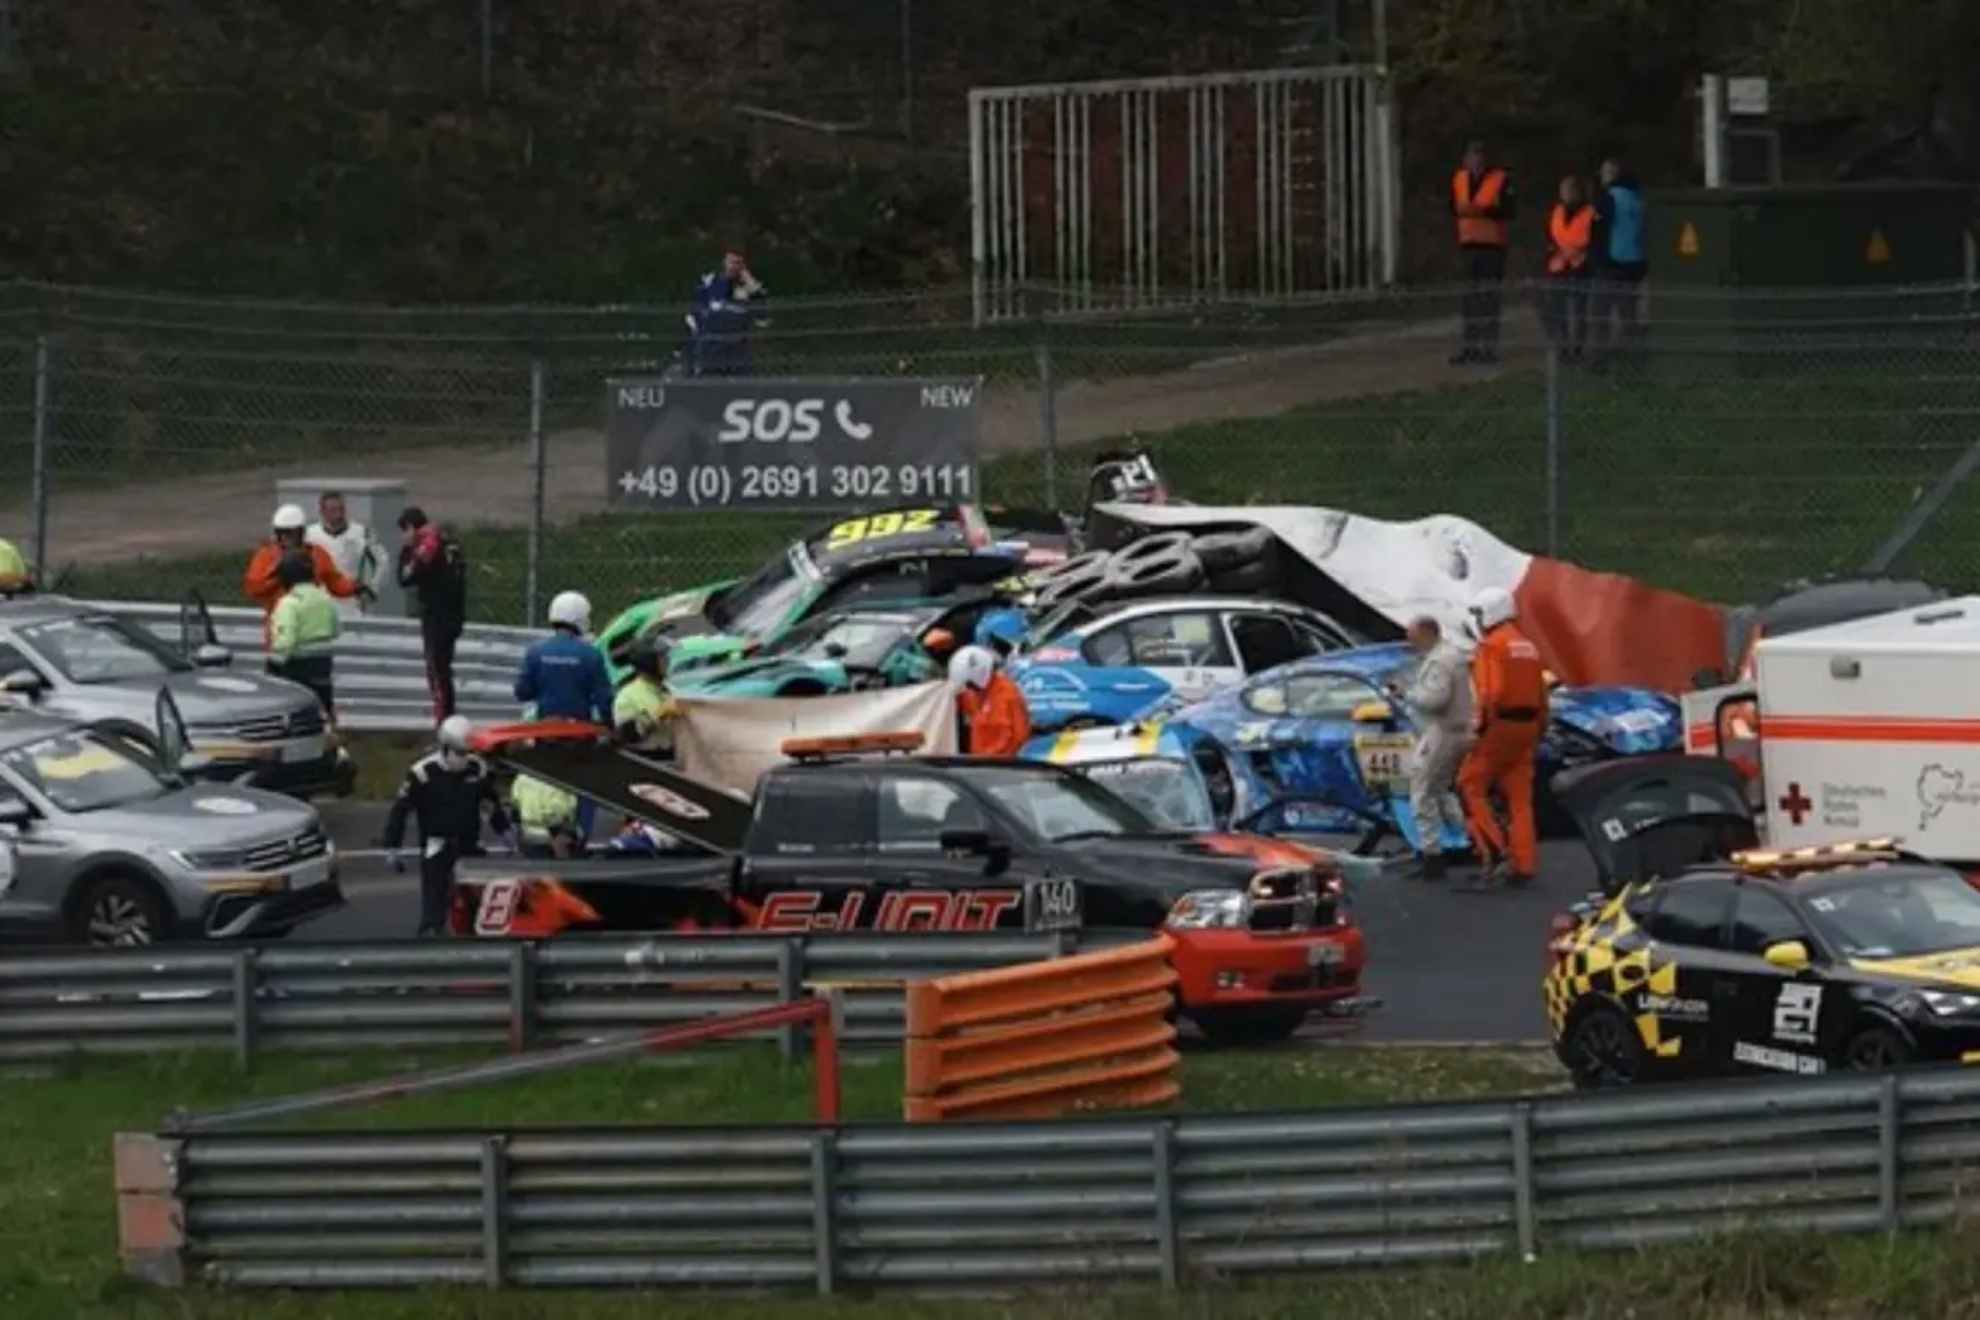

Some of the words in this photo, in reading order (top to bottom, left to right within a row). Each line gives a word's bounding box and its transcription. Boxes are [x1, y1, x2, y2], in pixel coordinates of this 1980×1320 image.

[618, 388, 664, 408] NEU
[920, 387, 973, 408] NEW
[718, 399, 824, 442] SOS
[618, 467, 678, 496] +49
[688, 465, 731, 502] (0)
[741, 466, 819, 496] 2691
[832, 466, 891, 496] 302
[899, 466, 972, 496] 9111
[826, 509, 942, 551] 992
